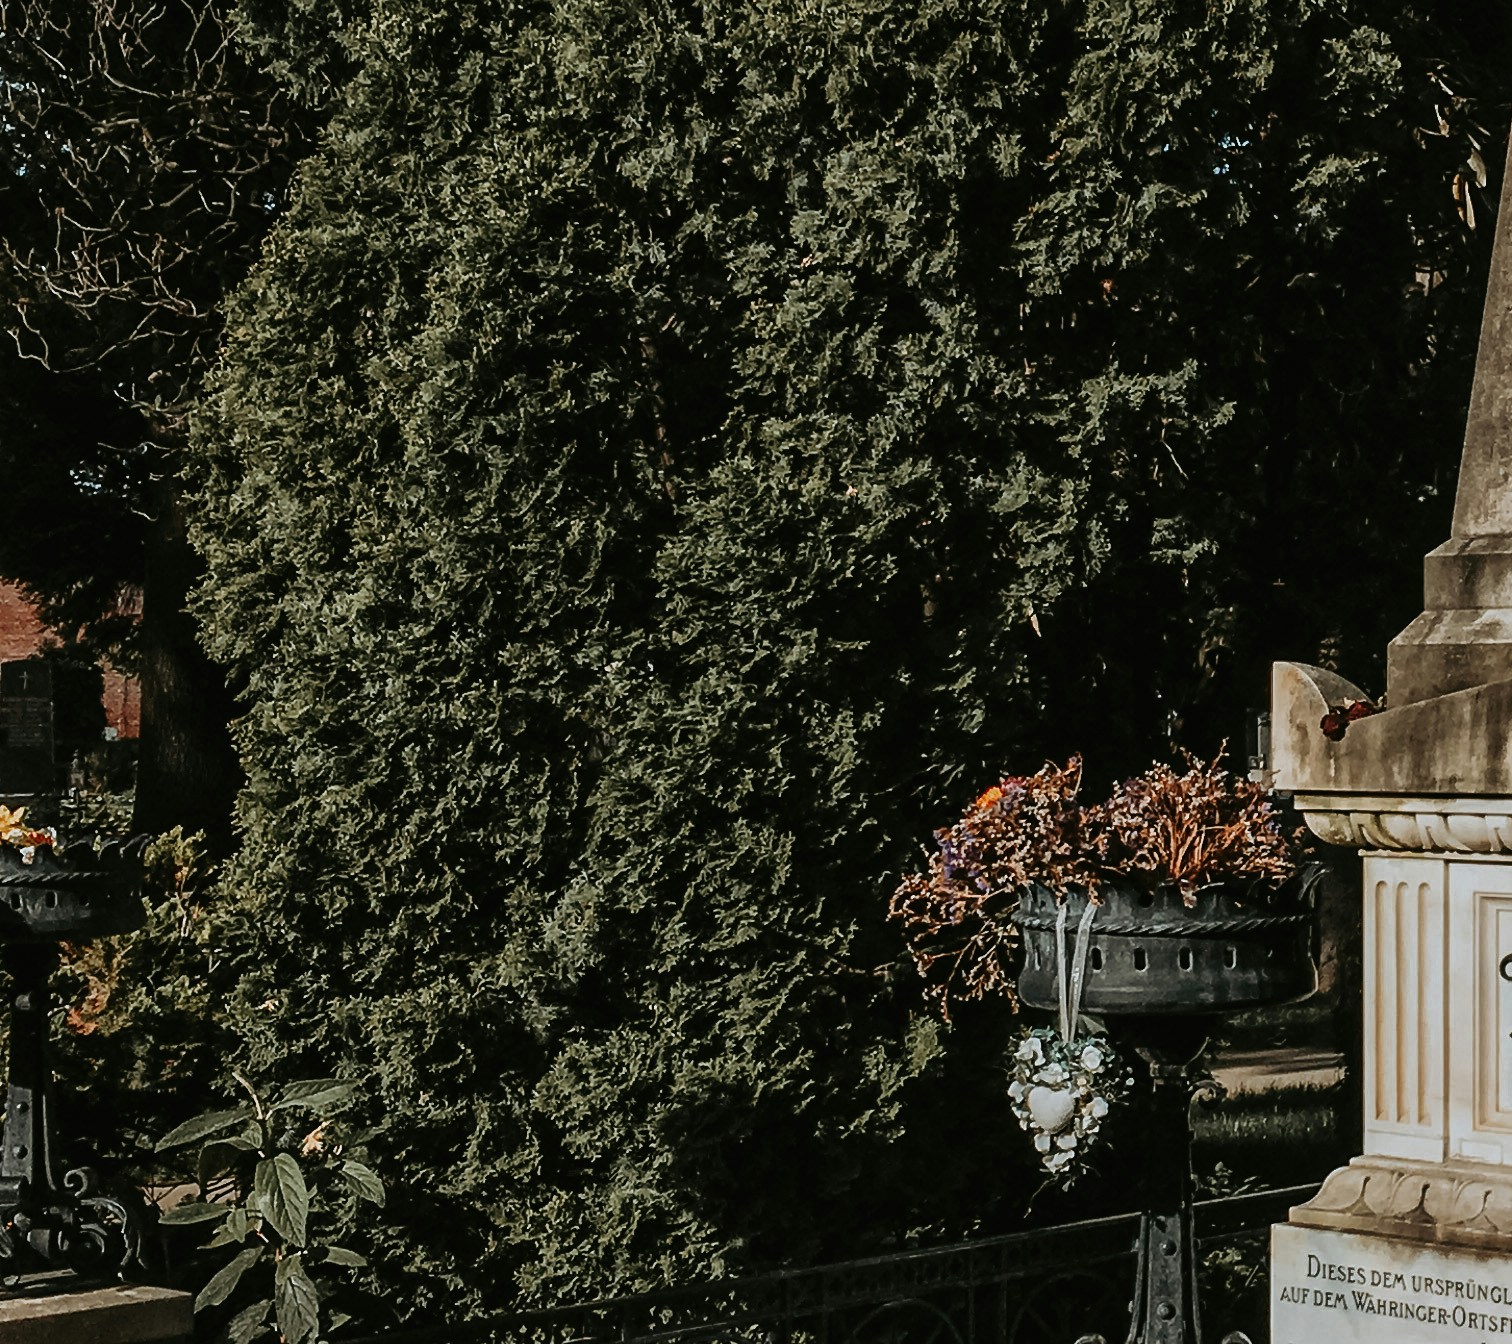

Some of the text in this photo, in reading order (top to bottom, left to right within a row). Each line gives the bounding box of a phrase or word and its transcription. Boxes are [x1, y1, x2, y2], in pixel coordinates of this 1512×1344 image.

[1306, 1254, 1366, 1285] DIESES
[1370, 1270, 1407, 1291] DEM
[1279, 1286, 1310, 1304] AUF
[1313, 1290, 1348, 1310] DEM
